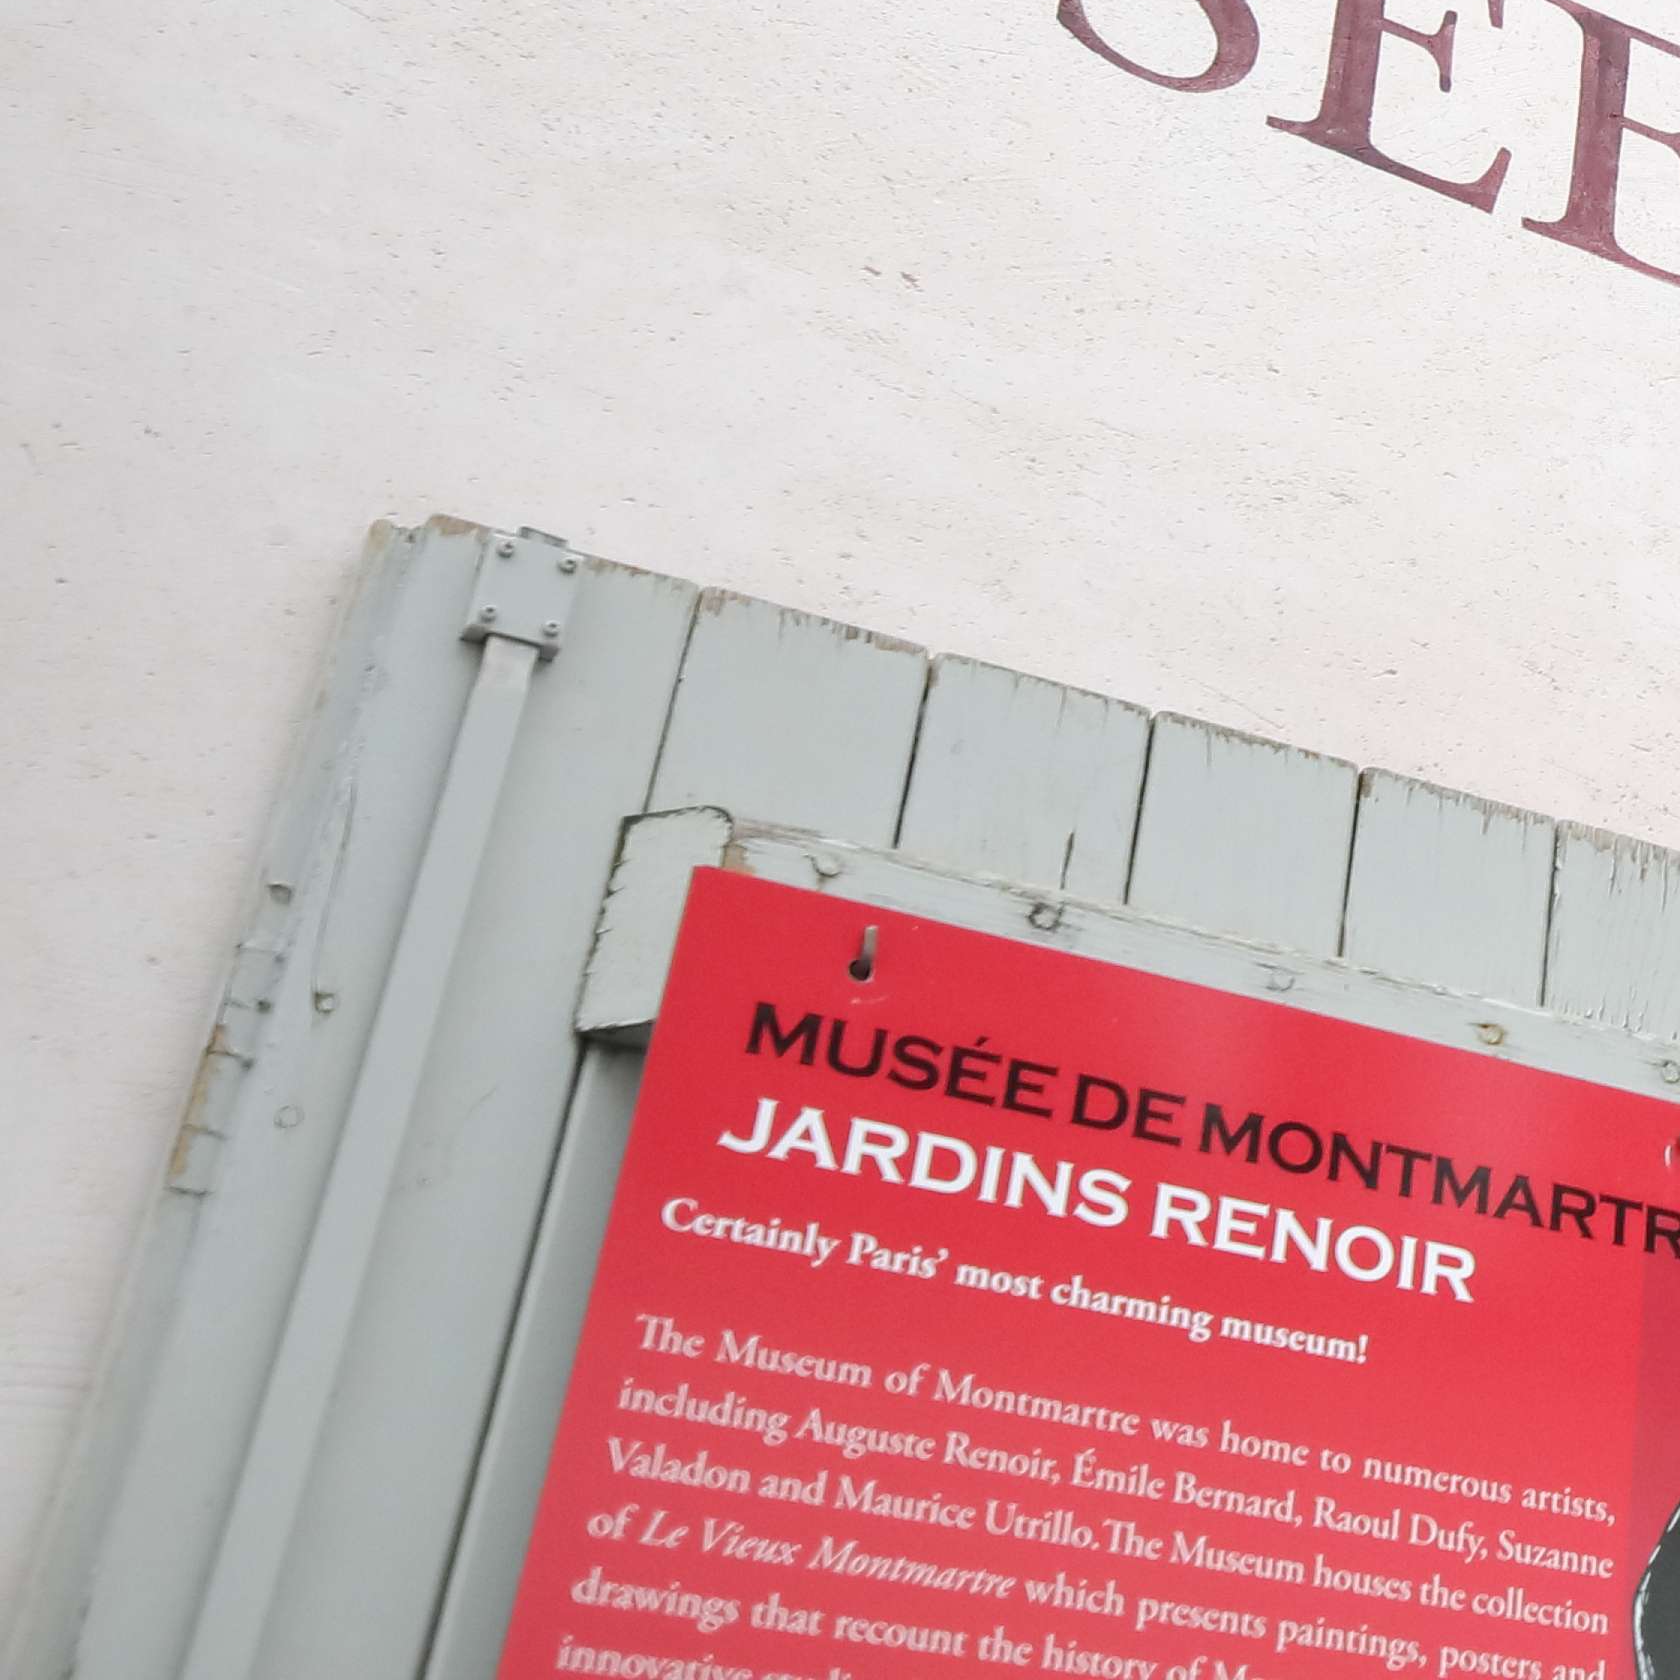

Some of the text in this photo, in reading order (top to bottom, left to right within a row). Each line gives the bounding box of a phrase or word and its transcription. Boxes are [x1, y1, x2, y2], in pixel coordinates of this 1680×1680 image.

[744, 1001, 1059, 1118] MUSÉE
[1070, 1074, 1188, 1147] DE
[661, 1197, 842, 1269] Certainly
[954, 1259, 1044, 1302] most
[1050, 1274, 1213, 1343] charming
[1220, 1316, 1370, 1364] museum!
[716, 1097, 1476, 1303] JARDINS RENOIR
[618, 1377, 1614, 1579] including Auguste Renoir, Émile Bernard, Raoul Dufy, Suzanne
[635, 1313, 1616, 1527] The Museum of Montmartre was home to numerous artists,
[570, 1566, 740, 1632] drawings
[751, 1593, 824, 1637] that
[834, 1614, 968, 1658] recount
[977, 1625, 1033, 1667] the
[1041, 1633, 1157, 1680] history
[587, 1503, 641, 1540] of
[641, 1509, 689, 1549] Le
[699, 1518, 801, 1567] Vieux
[807, 1535, 1017, 1600] Montmartre
[1024, 1571, 1126, 1617] which
[1136, 1596, 1267, 1640] presents
[1276, 1617, 1428, 1670] paintings,
[1439, 1644, 1542, 1680] posters
[607, 1437, 751, 1494] Valadon
[759, 1470, 827, 1507] and
[834, 1477, 978, 1530] Maurice
[1108, 1519, 1164, 1560] The
[1169, 1530, 1305, 1585] Museum
[1314, 1553, 1411, 1602] houses
[1419, 1574, 1465, 1613] the
[1472, 1586, 1609, 1635] collection
[556, 1635, 753, 1680] innovative
